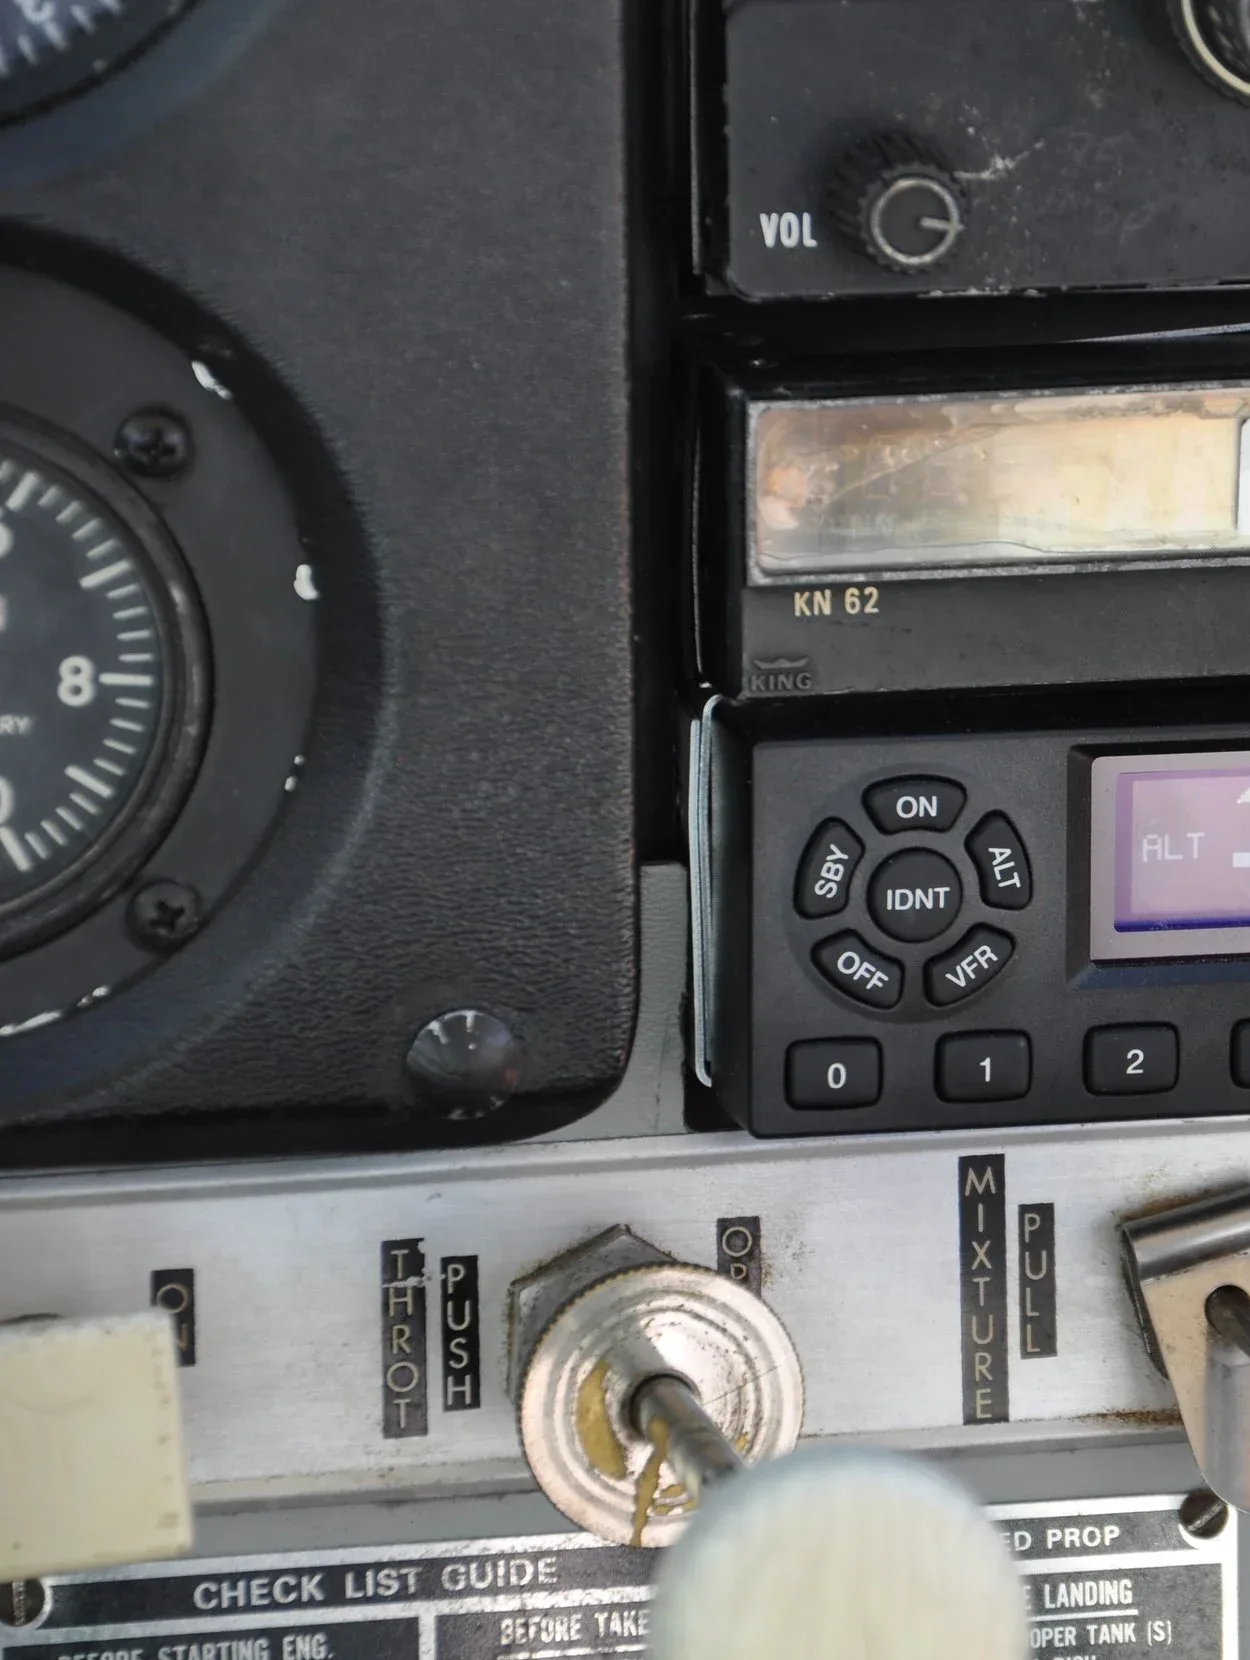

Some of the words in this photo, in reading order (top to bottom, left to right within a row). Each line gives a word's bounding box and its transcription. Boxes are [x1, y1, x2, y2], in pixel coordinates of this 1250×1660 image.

[760, 212, 817, 248] VOL
[794, 591, 831, 617] KN
[845, 587, 879, 615] 62
[57, 655, 96, 707] 8
[751, 673, 811, 691] KING
[896, 795, 938, 819] ON
[1142, 832, 1205, 862] ALT
[814, 844, 849, 899] SBY
[988, 847, 1021, 891] ALT
[886, 887, 950, 911] IDNT
[837, 951, 889, 990] OFF
[945, 945, 998, 988] VFR
[827, 1063, 847, 1089] 0
[979, 1057, 991, 1083] 1
[1126, 1049, 1145, 1074] 2
[965, 1166, 997, 1419] MIXTURE
[1024, 1213, 1048, 1354] PULL
[386, 1249, 418, 1429] THROT
[447, 1264, 471, 1405] PUSH
[1047, 1525, 1120, 1549] PROP
[193, 1574, 325, 1610] CHECK
[344, 1566, 421, 1599] LIST
[441, 1557, 558, 1591] GUIDE
[1044, 1579, 1133, 1609] LANDING
[501, 1612, 582, 1646] BEFORE
[1086, 1622, 1136, 1645] TANK
[1147, 1620, 1172, 1646] (S)
[282, 1632, 333, 1660] ENG.
